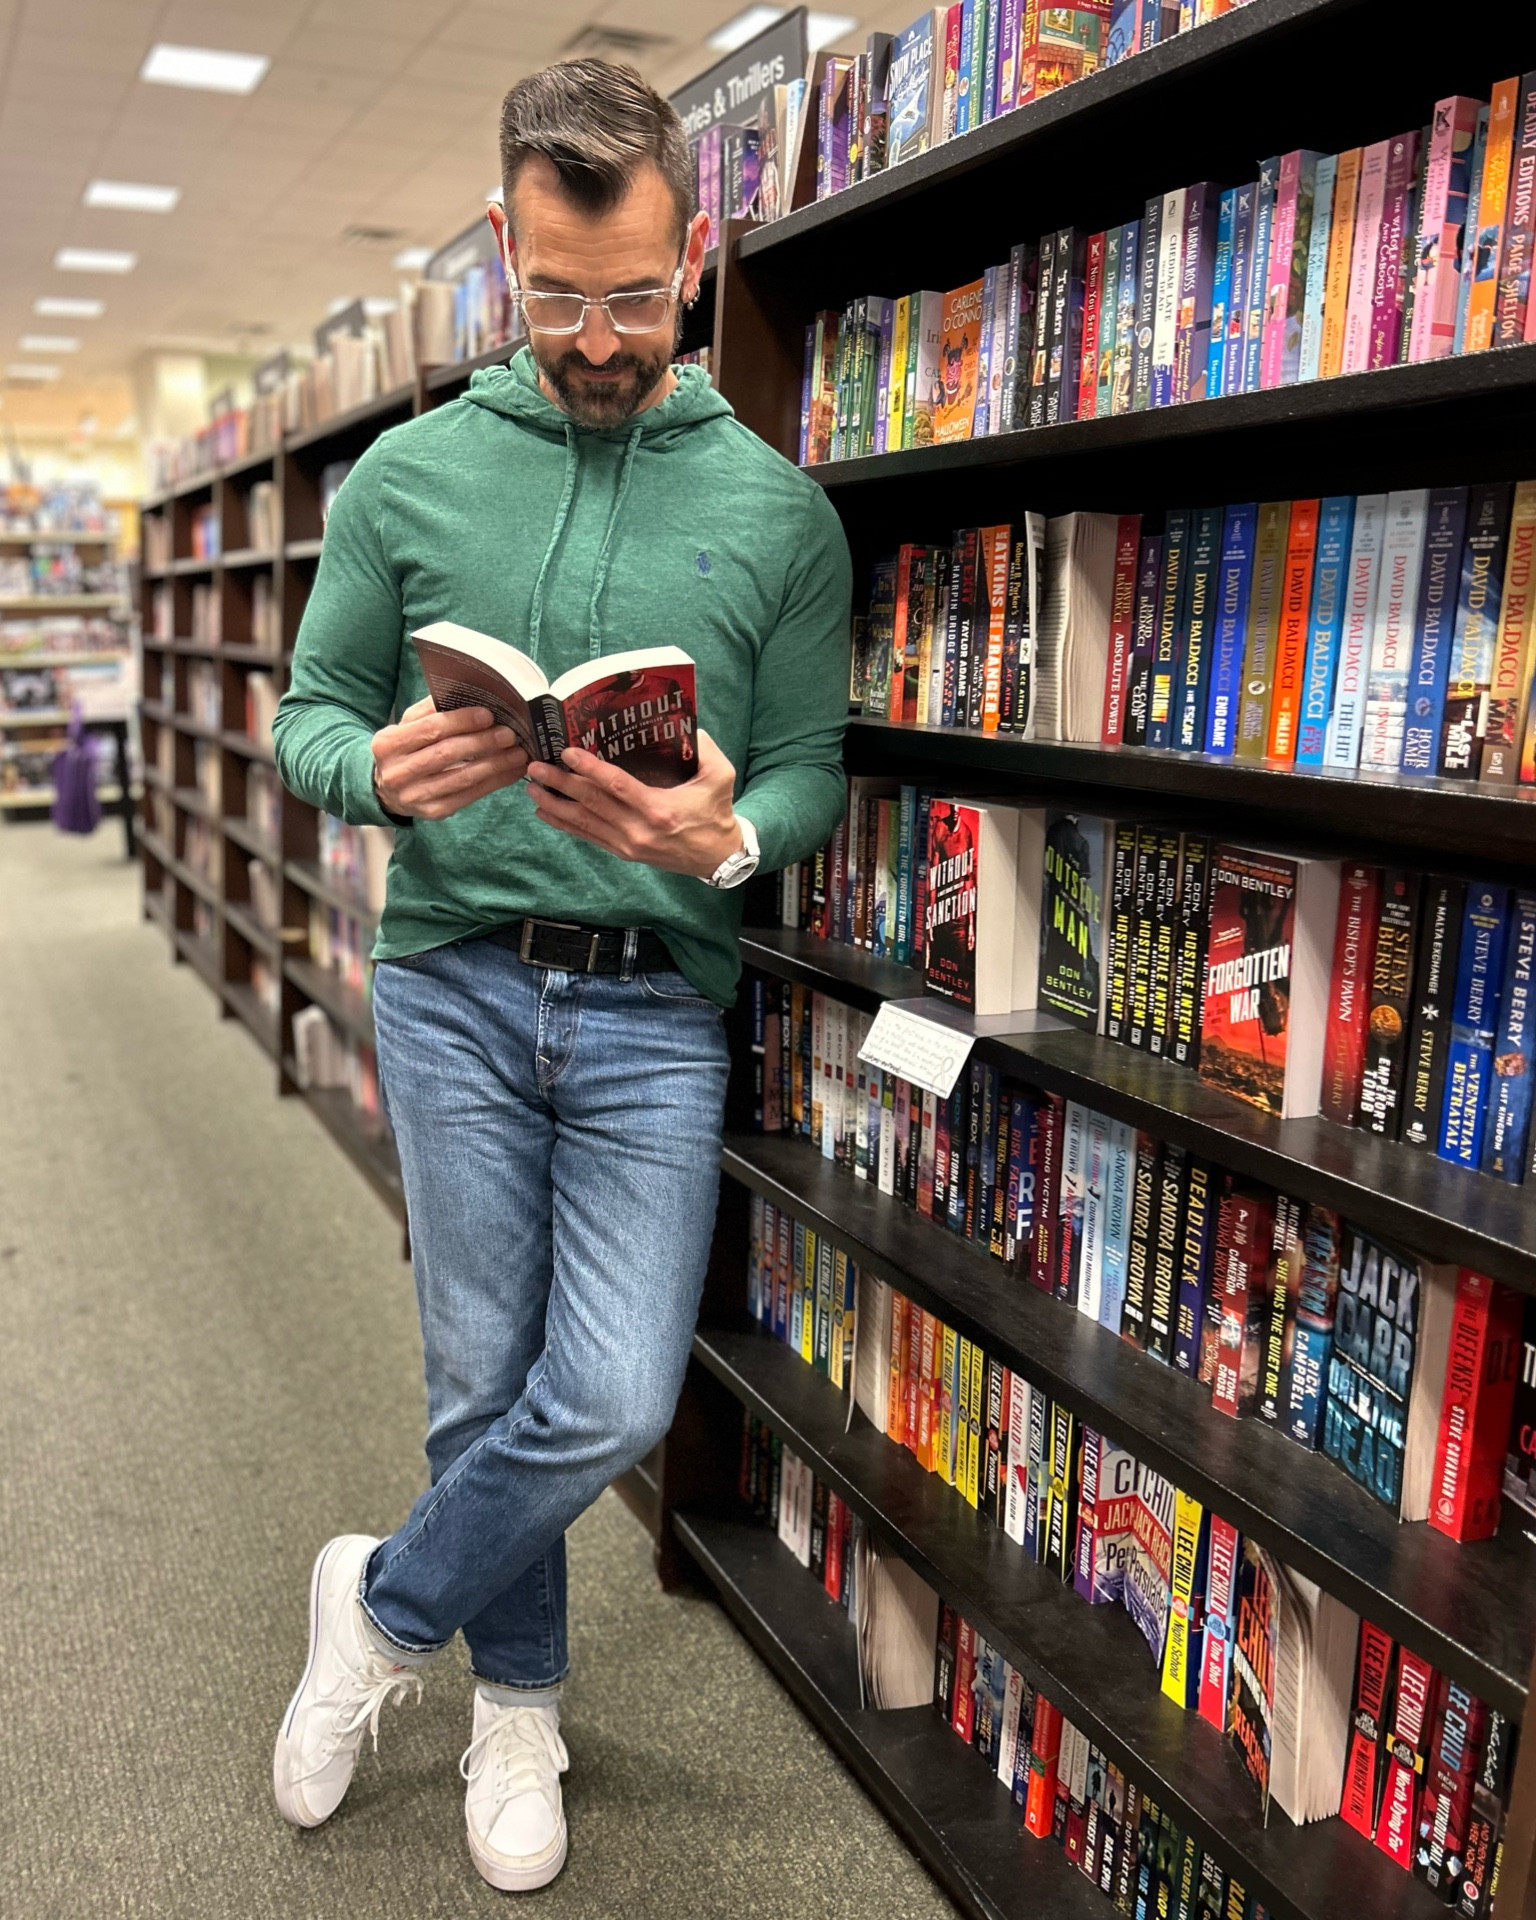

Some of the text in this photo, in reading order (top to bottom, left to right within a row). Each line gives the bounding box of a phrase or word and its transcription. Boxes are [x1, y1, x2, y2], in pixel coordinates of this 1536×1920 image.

[911, 35, 933, 66] PLACE
[714, 87, 726, 120] &
[727, 54, 784, 109] Thrillers
[1514, 159, 1536, 227] EDITIONS
[1141, 204, 1159, 322] SIX FEET DEEP DISH
[1183, 227, 1199, 292] BARBARA ROSS
[1232, 227, 1247, 304] TORN ASUNDER
[1253, 205, 1269, 306] MUDDLED THROUGH
[1386, 262, 1397, 288] CAT
[1508, 235, 1527, 276] PAIGE
[1500, 280, 1522, 338] SHELTON
[947, 565, 961, 654] HAIRPIN BRIDGE
[990, 541, 1008, 608] ATKINS
[1151, 548, 1180, 723] DAVID BALDACCI DAYLIGHT
[1417, 552, 1448, 685] DAVID BALDACCI
[957, 619, 970, 697] TAYLOR ADAMS
[985, 644, 1003, 714] RANGER
[1107, 632, 1125, 736] ABSOLUTE POWER
[1181, 572, 1207, 746] DAVID BALDACCI ESCAPE
[1211, 567, 1240, 747] DAVID BALDACCI END GAME
[1334, 556, 1372, 761] DAVID BALDACCI THE HIT
[581, 690, 684, 750] WITHOUT
[1402, 727, 1419, 767] GAME
[1416, 727, 1433, 768] HOUR
[1444, 724, 1461, 769] MILE
[1457, 721, 1474, 769] LAST
[930, 848, 974, 892] WITHOUT
[1046, 845, 1100, 924] OUTSIDE
[1217, 869, 1293, 900] DON BENTLEY
[925, 886, 977, 930] SANCTION
[1054, 894, 1088, 960] MAN
[929, 966, 969, 990] BENTLEY
[940, 957, 958, 973] DON
[1046, 975, 1093, 1000] BENTLEY
[1059, 964, 1080, 981] DON
[1178, 931, 1197, 1042] HOSTILE INTENT
[1207, 944, 1290, 997] FORGOTTEN
[1338, 915, 1361, 1021] BISHOP'S PAWN
[1372, 925, 1396, 995] BERRY
[1389, 930, 1411, 997] STEVE
[1465, 929, 1491, 1024] STEVE BERRY
[1506, 921, 1535, 1048] STEVE BERRY
[1230, 989, 1261, 1023] WAR
[1360, 1070, 1378, 1113] TOMB
[1371, 1056, 1392, 1132] EMPEROR'S
[1444, 1061, 1467, 1150] BETRAYAL
[1459, 1072, 1480, 1160] VENETIAN
[1493, 1081, 1509, 1151] LAST KINGDOM
[933, 1149, 947, 1201] DARK SKY
[947, 1151, 960, 1217] STORM WATCH
[1040, 1103, 1056, 1219] THE WRONG VICTIM
[1109, 1146, 1126, 1240] SANDRA BROWN
[1082, 1200, 1097, 1300] COUNTDOWN TO MIDNIGHT
[1126, 1168, 1153, 1307] SANDRA BROWN
[1151, 1179, 1179, 1321] SANDRA BROWN
[1181, 1167, 1208, 1288] DEADLOCK
[1272, 1195, 1288, 1252] CAMPBELL
[1284, 1204, 1299, 1253] MICHELE
[1224, 1247, 1240, 1296] CAMERON
[1236, 1261, 1248, 1291] MARC
[1342, 1237, 1418, 1333] JACK
[1264, 1258, 1289, 1397] SHE WAS THE QUIET ONE
[1333, 1291, 1412, 1397] CARR
[1215, 1363, 1229, 1398] CROSS
[1225, 1367, 1238, 1403] STONE
[1289, 1329, 1309, 1411] CAMPBELL
[1306, 1359, 1320, 1398] RICK
[1050, 1417, 1069, 1557] LEE CHILD MAKE ME
[1441, 1405, 1466, 1499] STEVE CAVANAGH
[1079, 1440, 1099, 1580] LEE CHILD Persuader
[1168, 1526, 1191, 1682] LEE CHILD Night School
[1207, 1541, 1232, 1688] LEE CHILD One Shot
[1349, 1635, 1385, 1820] LEE CHILD MIDNIGHT LINE
[1386, 1664, 1426, 1854] LEE CHILD Worth Dying For
[1439, 1709, 1468, 1772] CHILD
[1084, 1800, 1098, 1873] DARKEST FEAR
[1100, 1833, 1114, 1892] BACK SPIN
[1429, 1793, 1451, 1867] WITHOUT FAIL
[1119, 1855, 1130, 1894] LET GO
